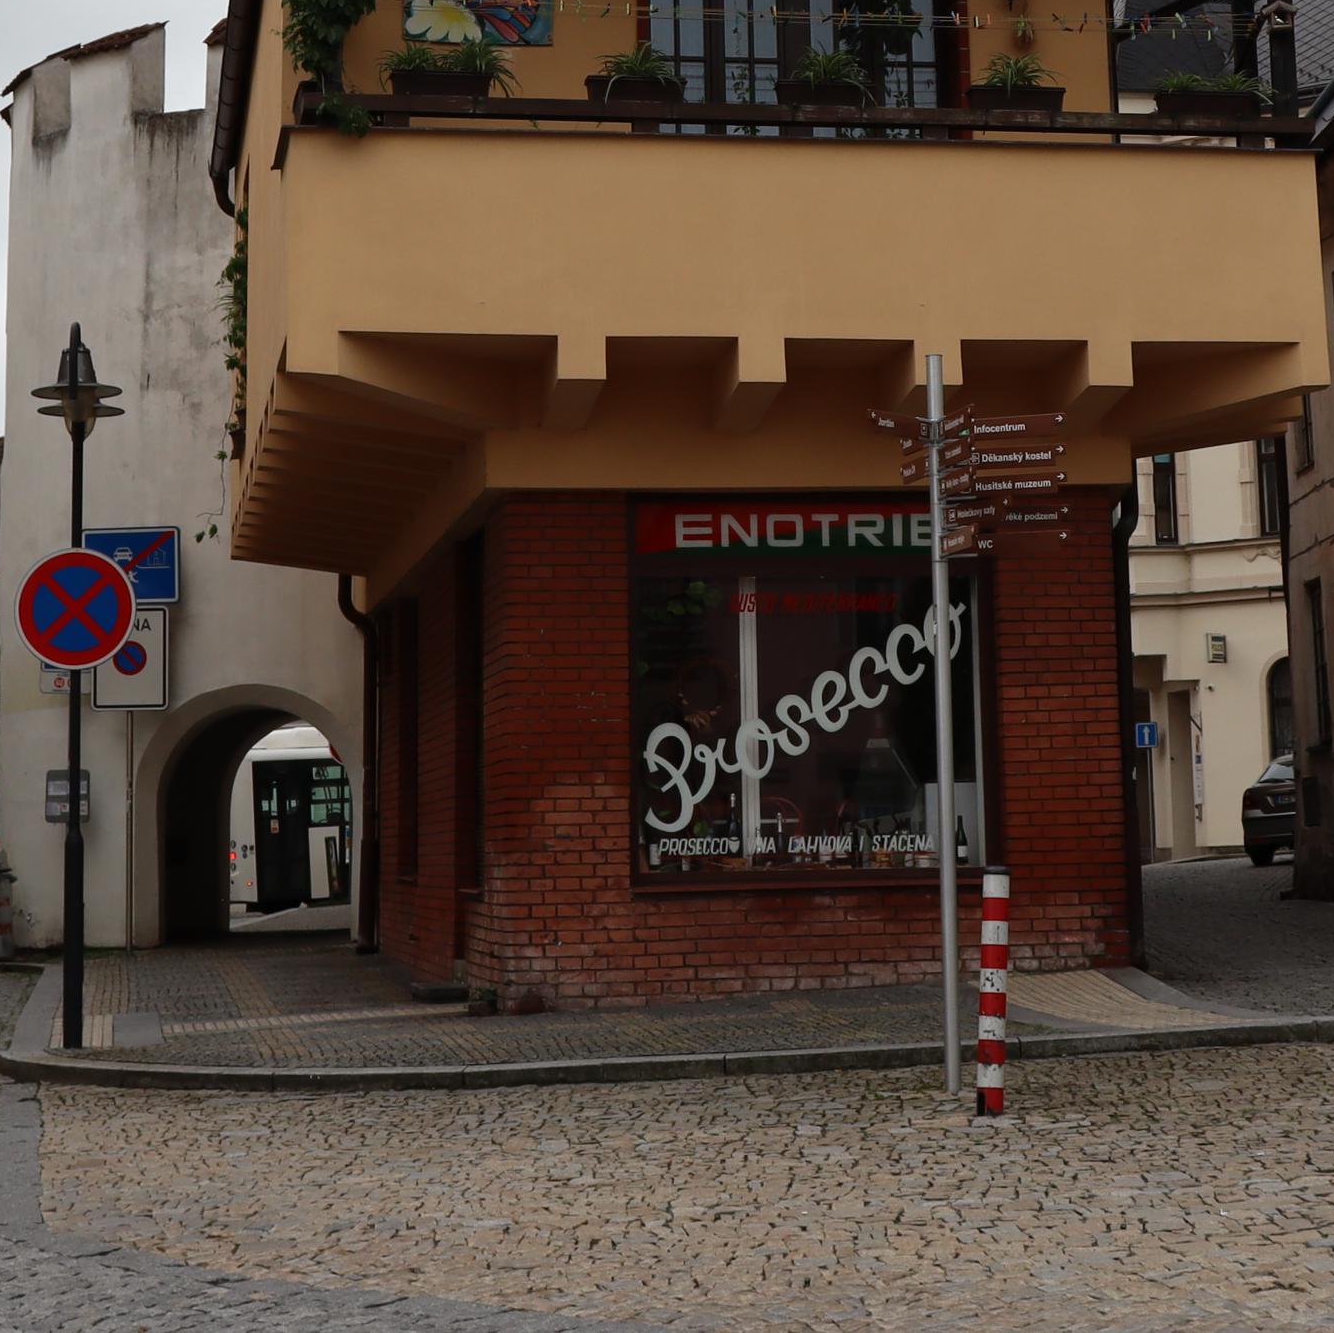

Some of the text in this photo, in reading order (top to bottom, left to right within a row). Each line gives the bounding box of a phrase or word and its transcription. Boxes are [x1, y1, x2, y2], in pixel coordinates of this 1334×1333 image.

[974, 423, 1026, 434] Infocentrum
[981, 451, 1052, 464] Děkanský kostel
[975, 480, 1013, 491] Husitské
[1014, 479, 1051, 490] muzeum
[977, 540, 994, 550] WC
[643, 601, 966, 832] Prosecco
[659, 837, 728, 856] PROSECCO
